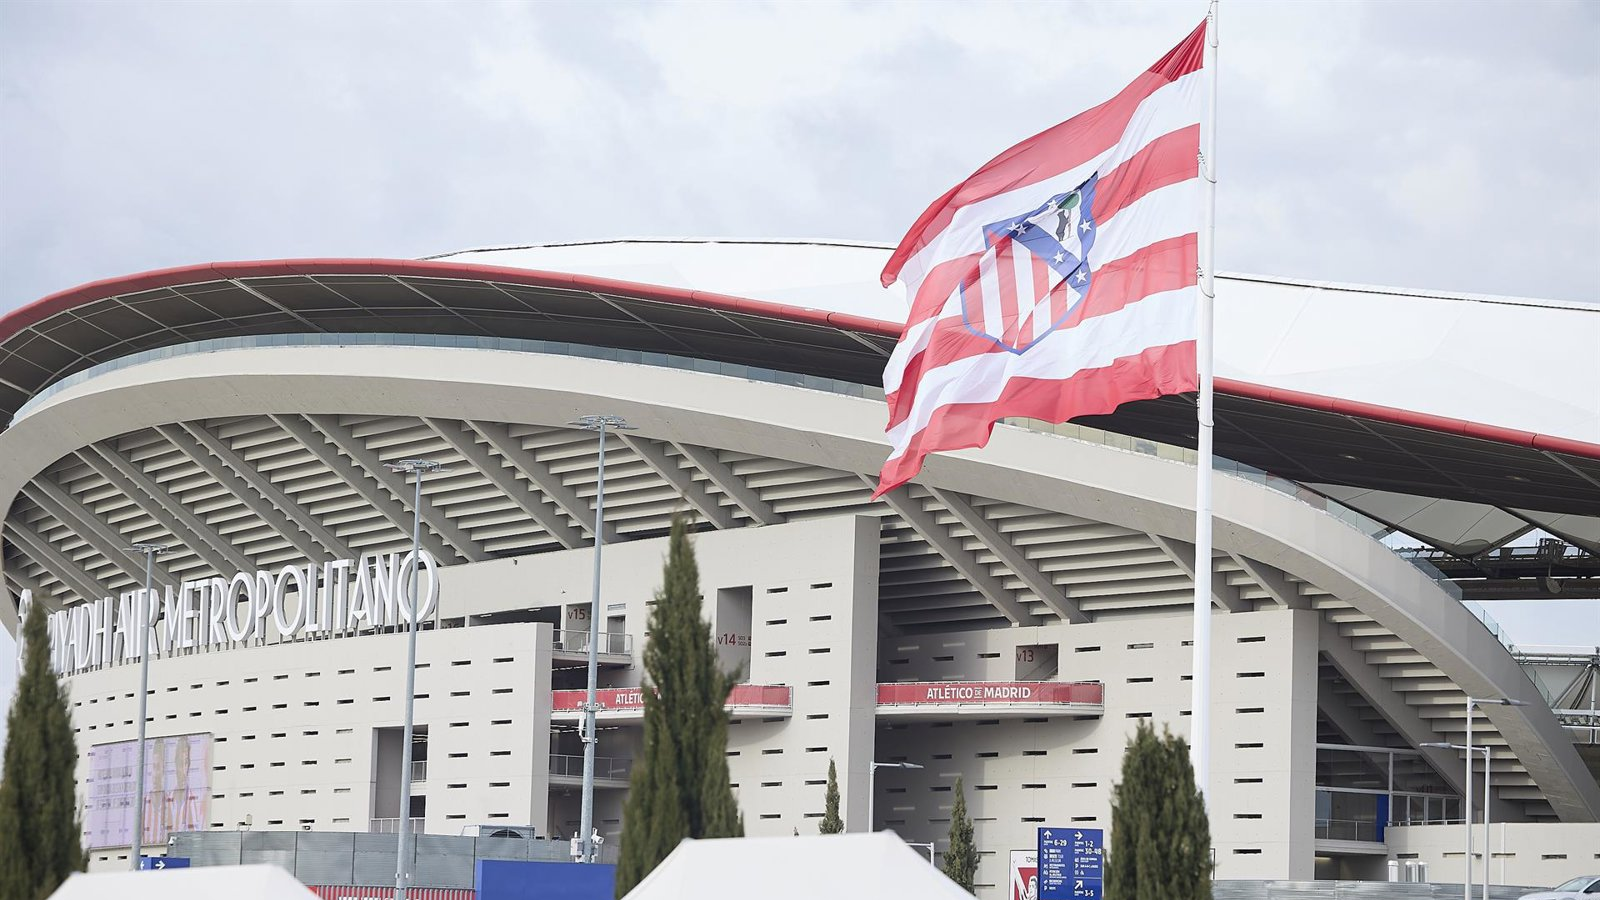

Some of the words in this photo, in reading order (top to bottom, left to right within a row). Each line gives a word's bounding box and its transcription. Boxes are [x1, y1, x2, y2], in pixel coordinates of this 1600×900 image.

[112, 588, 160, 659] AIR
[163, 550, 439, 651] METROPOLITANO
[568, 608, 586, 620] v15
[717, 633, 736, 645] v14
[1016, 650, 1034, 662] v13
[615, 689, 645, 705] ATLÉTIC
[926, 685, 973, 699] ATLÉTICO
[984, 687, 1031, 699] MADRID
